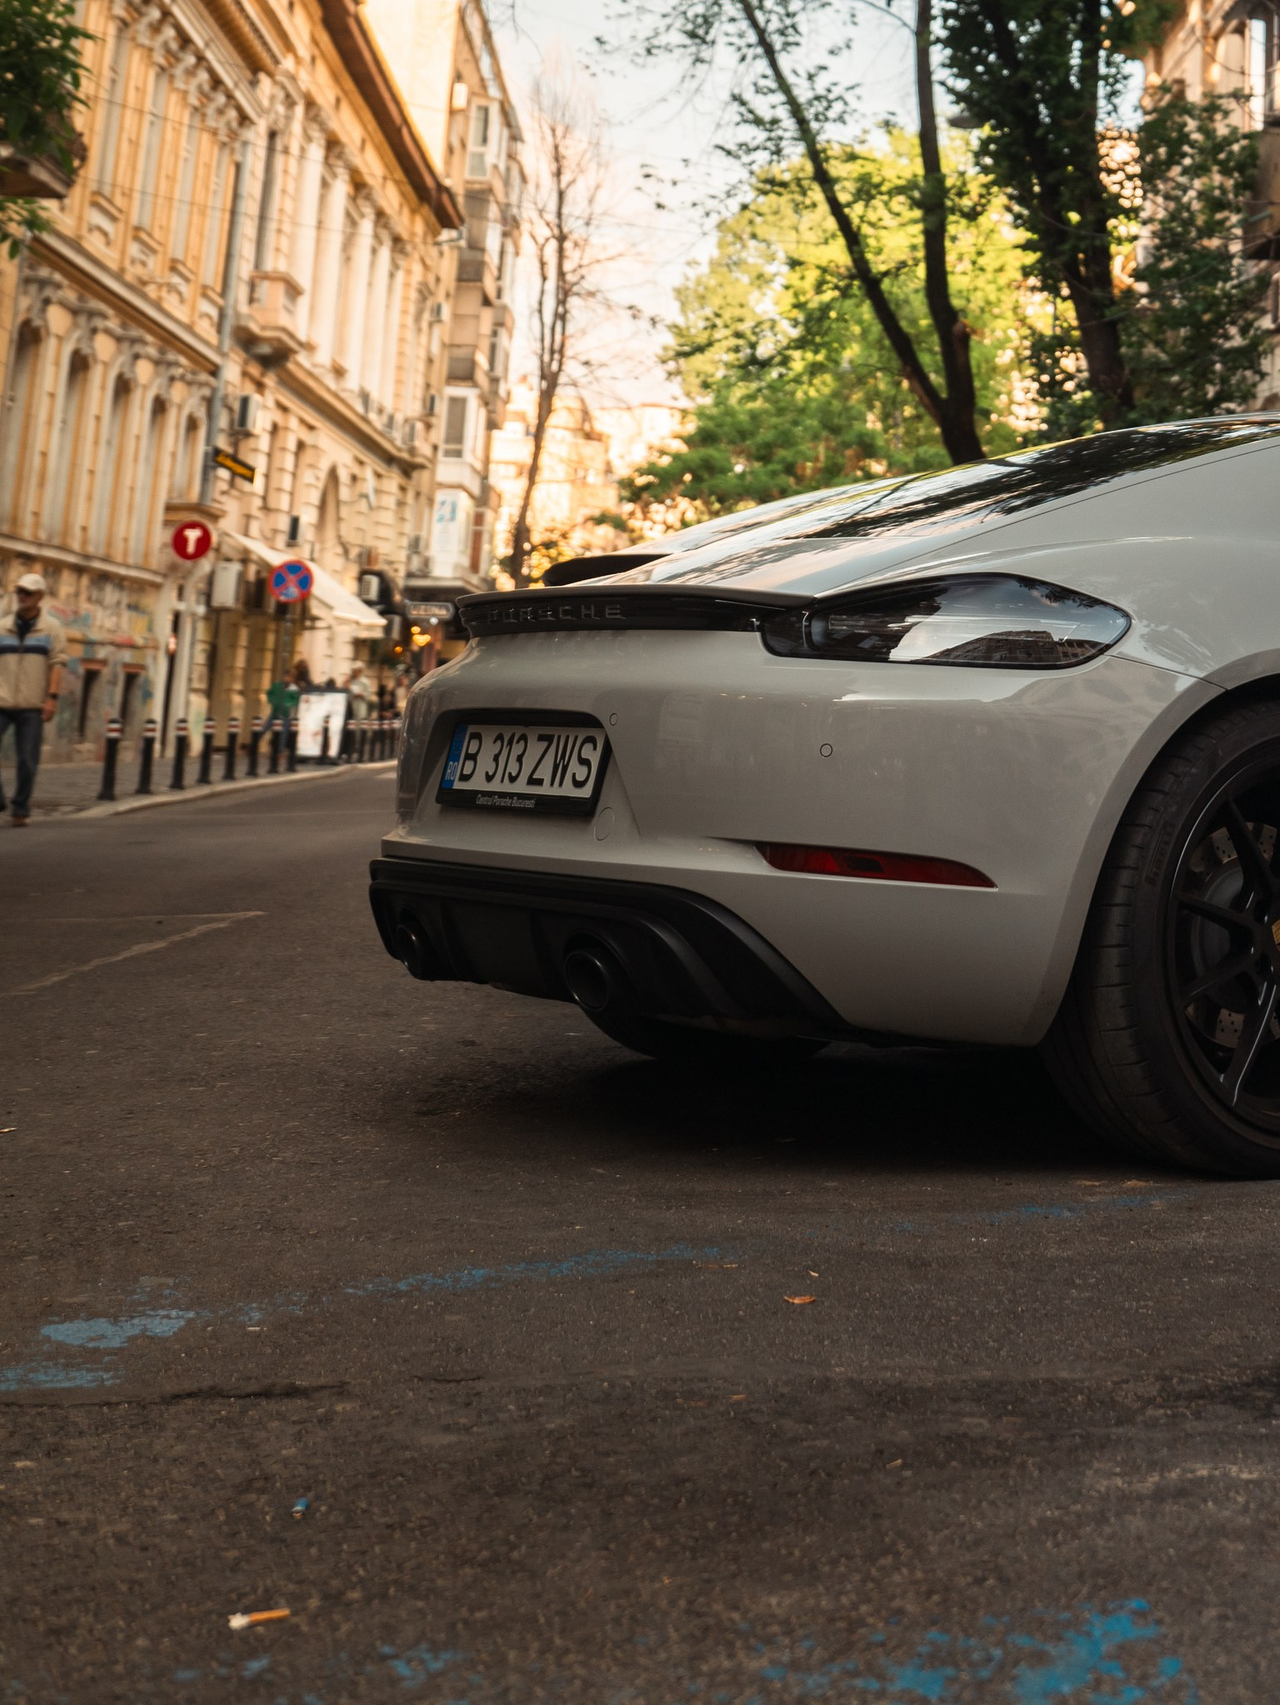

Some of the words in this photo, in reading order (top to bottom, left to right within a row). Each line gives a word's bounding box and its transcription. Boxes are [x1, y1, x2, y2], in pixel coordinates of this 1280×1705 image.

[487, 603, 626, 625] PORSCHE
[458, 732, 483, 782] B
[485, 732, 528, 783] 313
[526, 733, 597, 788] ZWS
[445, 761, 459, 781] RO
[493, 795, 512, 806] Porsche
